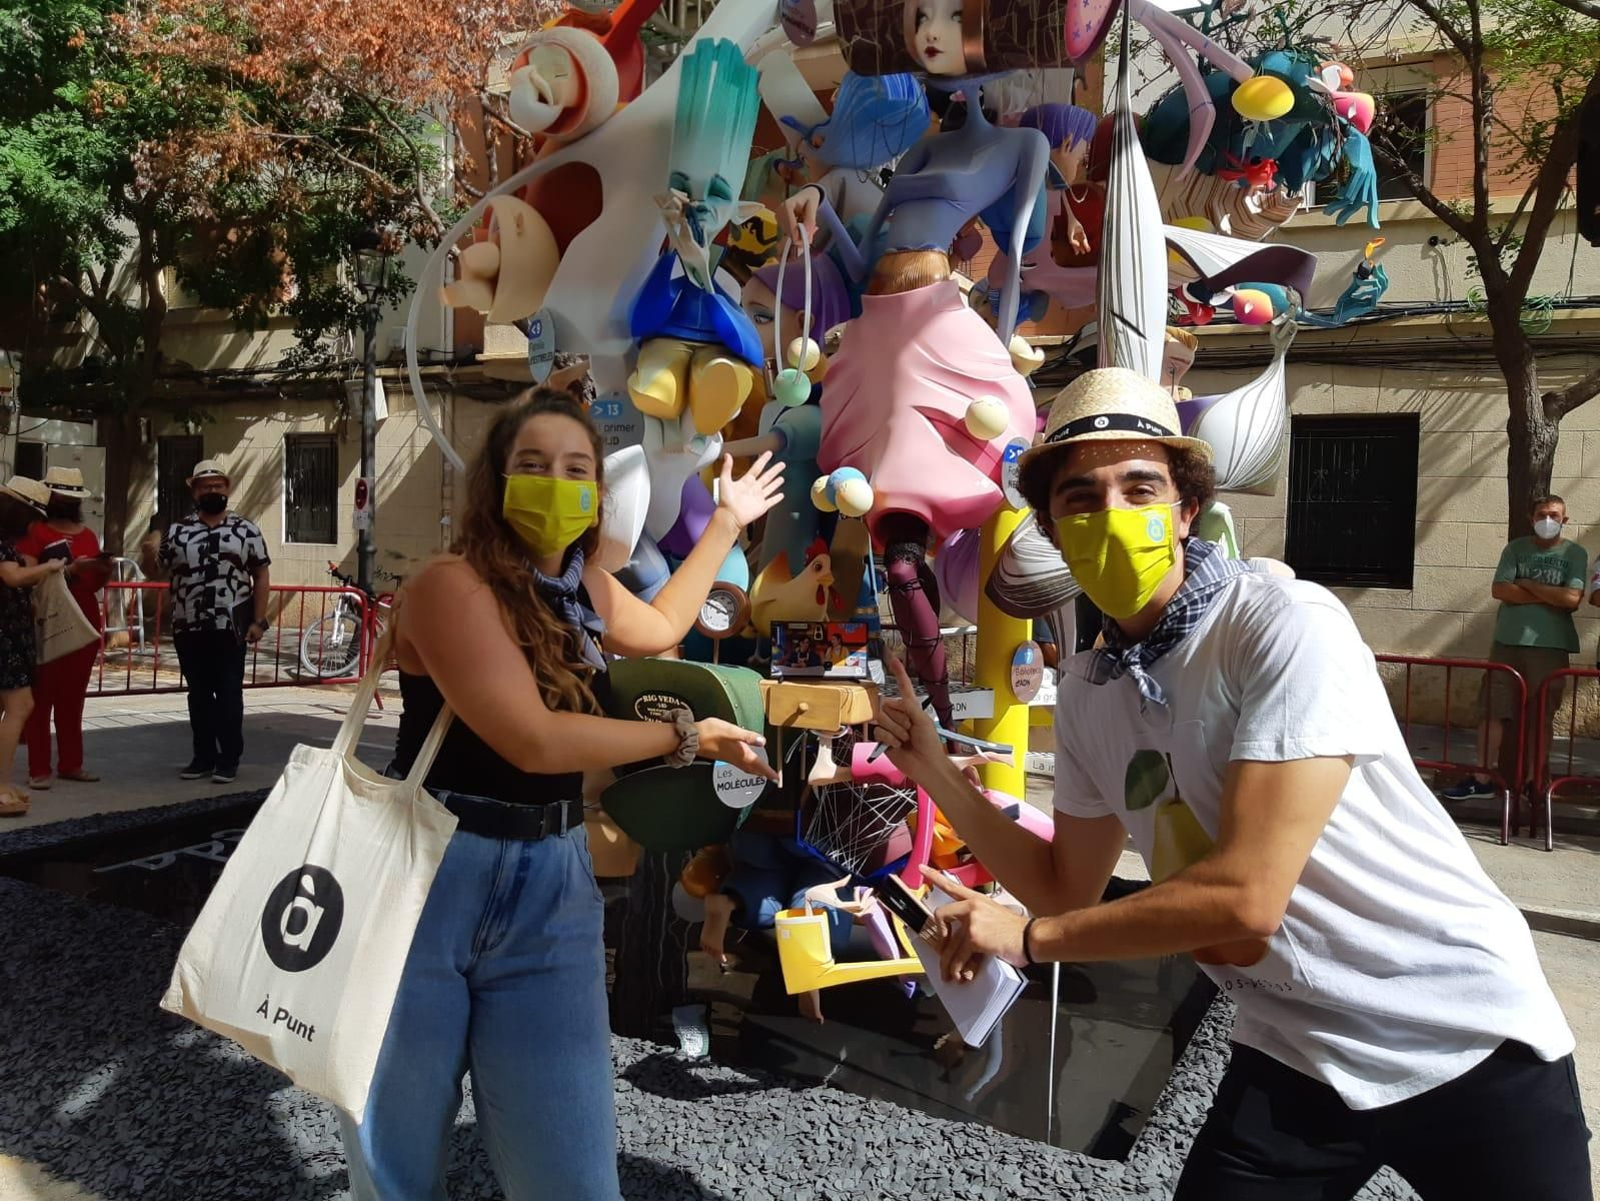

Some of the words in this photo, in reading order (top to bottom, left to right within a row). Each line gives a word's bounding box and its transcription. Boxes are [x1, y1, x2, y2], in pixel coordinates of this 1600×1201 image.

[603, 424, 635, 433] primer
[1033, 761, 1044, 771] La
[717, 770, 733, 779] Les
[272, 1006, 316, 1043] Punt
